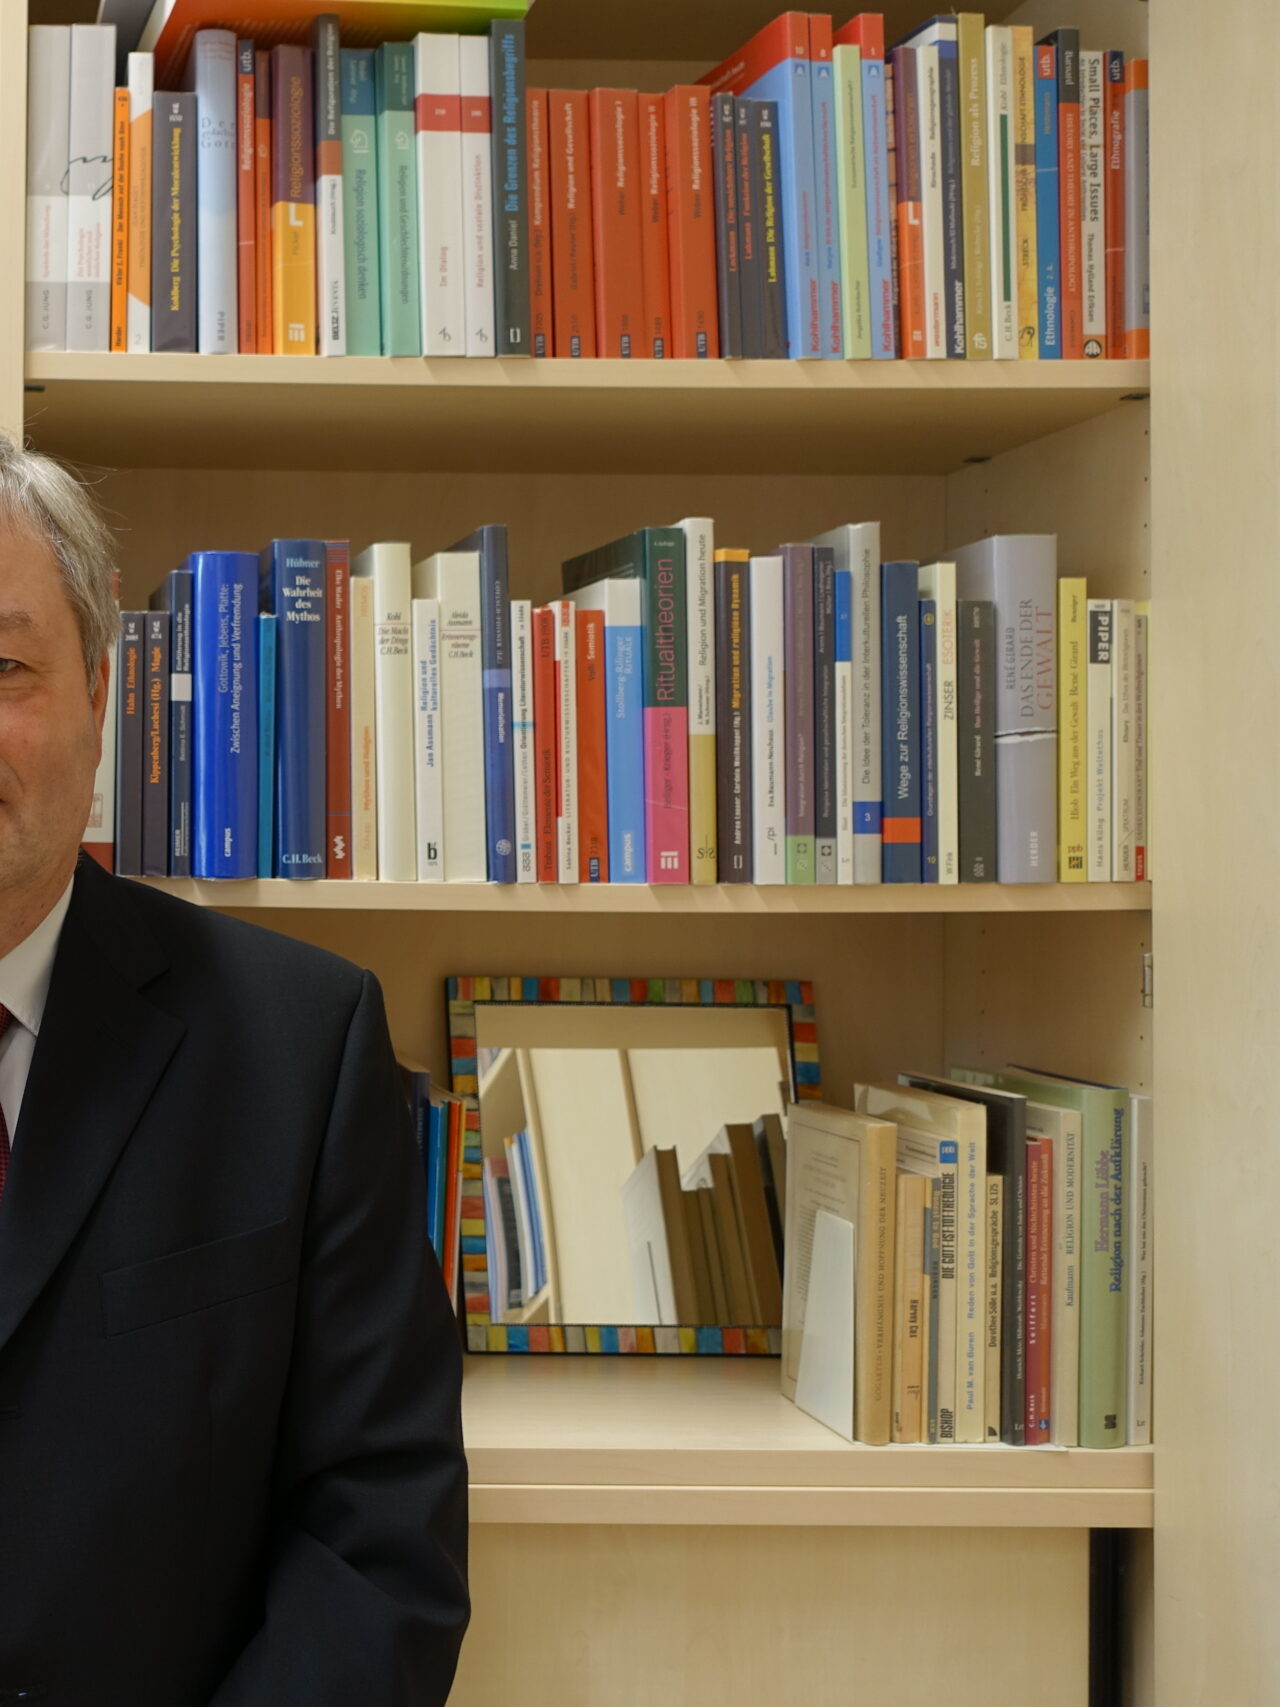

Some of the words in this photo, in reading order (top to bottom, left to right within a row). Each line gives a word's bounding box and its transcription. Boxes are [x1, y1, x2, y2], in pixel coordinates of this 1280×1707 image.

[242, 49, 252, 71] utb.
[1040, 53, 1052, 76] utb.
[1088, 59, 1099, 91] Small
[1111, 58, 1120, 79] utb.
[504, 35, 518, 123] Religionsbegriffs
[969, 58, 979, 99] Prozess
[242, 83, 252, 170] Religionssoziologie
[970, 103, 979, 117] als
[290, 77, 304, 198] Religionssoziologie
[505, 127, 517, 146] des
[970, 121, 982, 166] Religion
[1110, 111, 1121, 169] Ethnografie
[505, 149, 518, 192] Grenzen
[1089, 145, 1100, 178] Large
[505, 195, 518, 212] Die
[1089, 183, 1100, 222] Issues
[808, 279, 819, 352] Kohlhammer
[830, 281, 840, 352] Kohlhammer
[881, 279, 892, 351] Kohlhammer
[953, 281, 964, 352] Kohlhammer
[1044, 287, 1056, 346] Ethnologie
[286, 558, 321, 568] Hübner
[697, 535, 706, 562] heute
[295, 576, 311, 585] Die
[697, 565, 708, 607] Migration
[861, 549, 871, 598] Philosophie
[282, 586, 322, 597] Wahrheit
[295, 598, 311, 608] des
[231, 584, 243, 641] Verfremdung
[286, 611, 320, 624] Mythos
[698, 610, 707, 626] und
[1020, 599, 1032, 631] DER
[220, 616, 231, 647] Jebens,
[656, 559, 675, 700] Ritualtheorien
[861, 601, 871, 664] Interkulturellen
[943, 609, 952, 664] ESOTERIK
[1005, 627, 1015, 664] GIRARD
[1098, 615, 1109, 660] PIPER
[151, 647, 161, 672] Magie
[231, 643, 241, 660] und
[698, 630, 709, 665] Religion
[1020, 635, 1033, 680] ENDE
[1036, 606, 1053, 710] GEWALT
[126, 648, 138, 688] Ethnologie
[219, 651, 230, 692] Gottowik,
[861, 666, 870, 680] der
[896, 615, 911, 740] Religionswissenschaft
[1003, 666, 1015, 689] RENÉ
[231, 663, 243, 710] Aneignung
[861, 682, 870, 690] in
[943, 681, 953, 720] ZINSER
[1020, 683, 1033, 717] DAS
[127, 693, 136, 714] Hahn
[861, 693, 870, 729] Toleranz
[231, 712, 241, 753] Zwischen
[861, 732, 870, 746] der
[861, 749, 870, 767] Idee
[899, 744, 909, 762] zur
[861, 770, 870, 784] Die
[898, 768, 911, 799] Wege
[224, 828, 232, 857] campus
[623, 834, 632, 872] campus
[1030, 831, 1038, 867] HERDER
[967, 1142, 975, 1162] Welt
[1064, 1132, 1074, 1187] MODERNITÄT
[1109, 1108, 1123, 1182] Aufklärung
[967, 1165, 975, 1179] der
[1096, 1150, 1109, 1188] Lübbe
[967, 1182, 976, 1218] Sprache
[1066, 1191, 1074, 1210] UND
[1111, 1185, 1123, 1203] der
[967, 1222, 975, 1236] der
[1065, 1213, 1074, 1254] RELIGION
[1096, 1192, 1109, 1252] Hermann
[1111, 1206, 1123, 1237] nach
[941, 1267, 954, 1279] DIE
[967, 1251, 975, 1269] Gott
[1109, 1240, 1123, 1292] Religion
[1065, 1265, 1074, 1307] Kaufmann
[967, 1293, 975, 1319] Reden
[967, 1332, 975, 1358] Buren
[967, 1380, 975, 1388] M.
[967, 1391, 975, 1409] Paul
[940, 1408, 953, 1438] BISHOP
